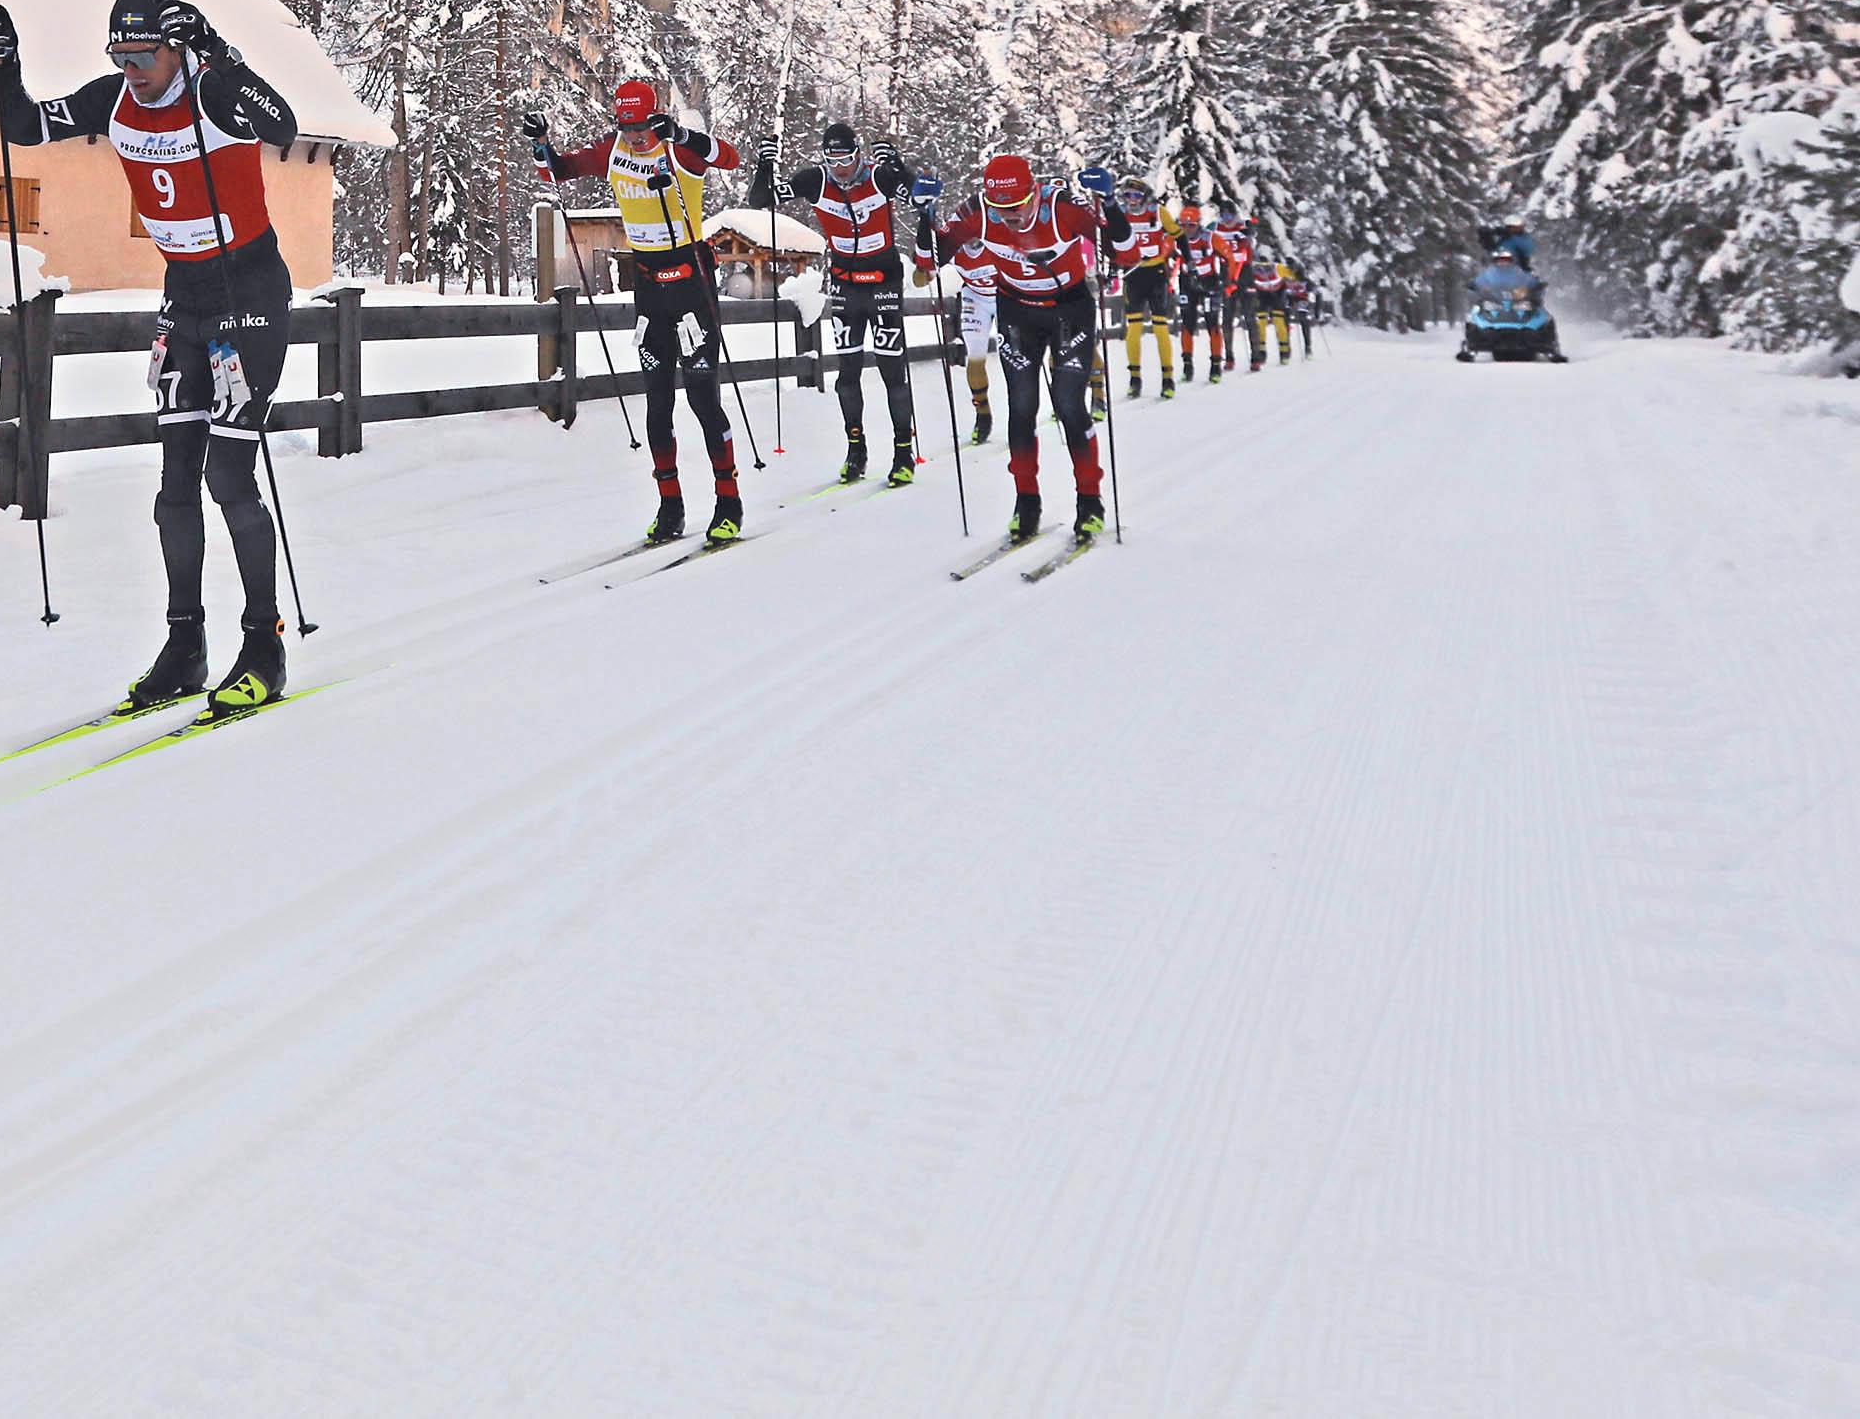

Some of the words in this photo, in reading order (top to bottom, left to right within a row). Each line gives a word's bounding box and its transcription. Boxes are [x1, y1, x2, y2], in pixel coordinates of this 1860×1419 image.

[126, 32, 162, 41] Moelven
[44, 99, 76, 126] 57
[612, 155, 640, 173] WATCH
[151, 168, 176, 209] 9
[776, 183, 796, 199] 57
[657, 270, 682, 280] COXA
[1020, 260, 1037, 277] 5
[874, 326, 901, 348] 57
